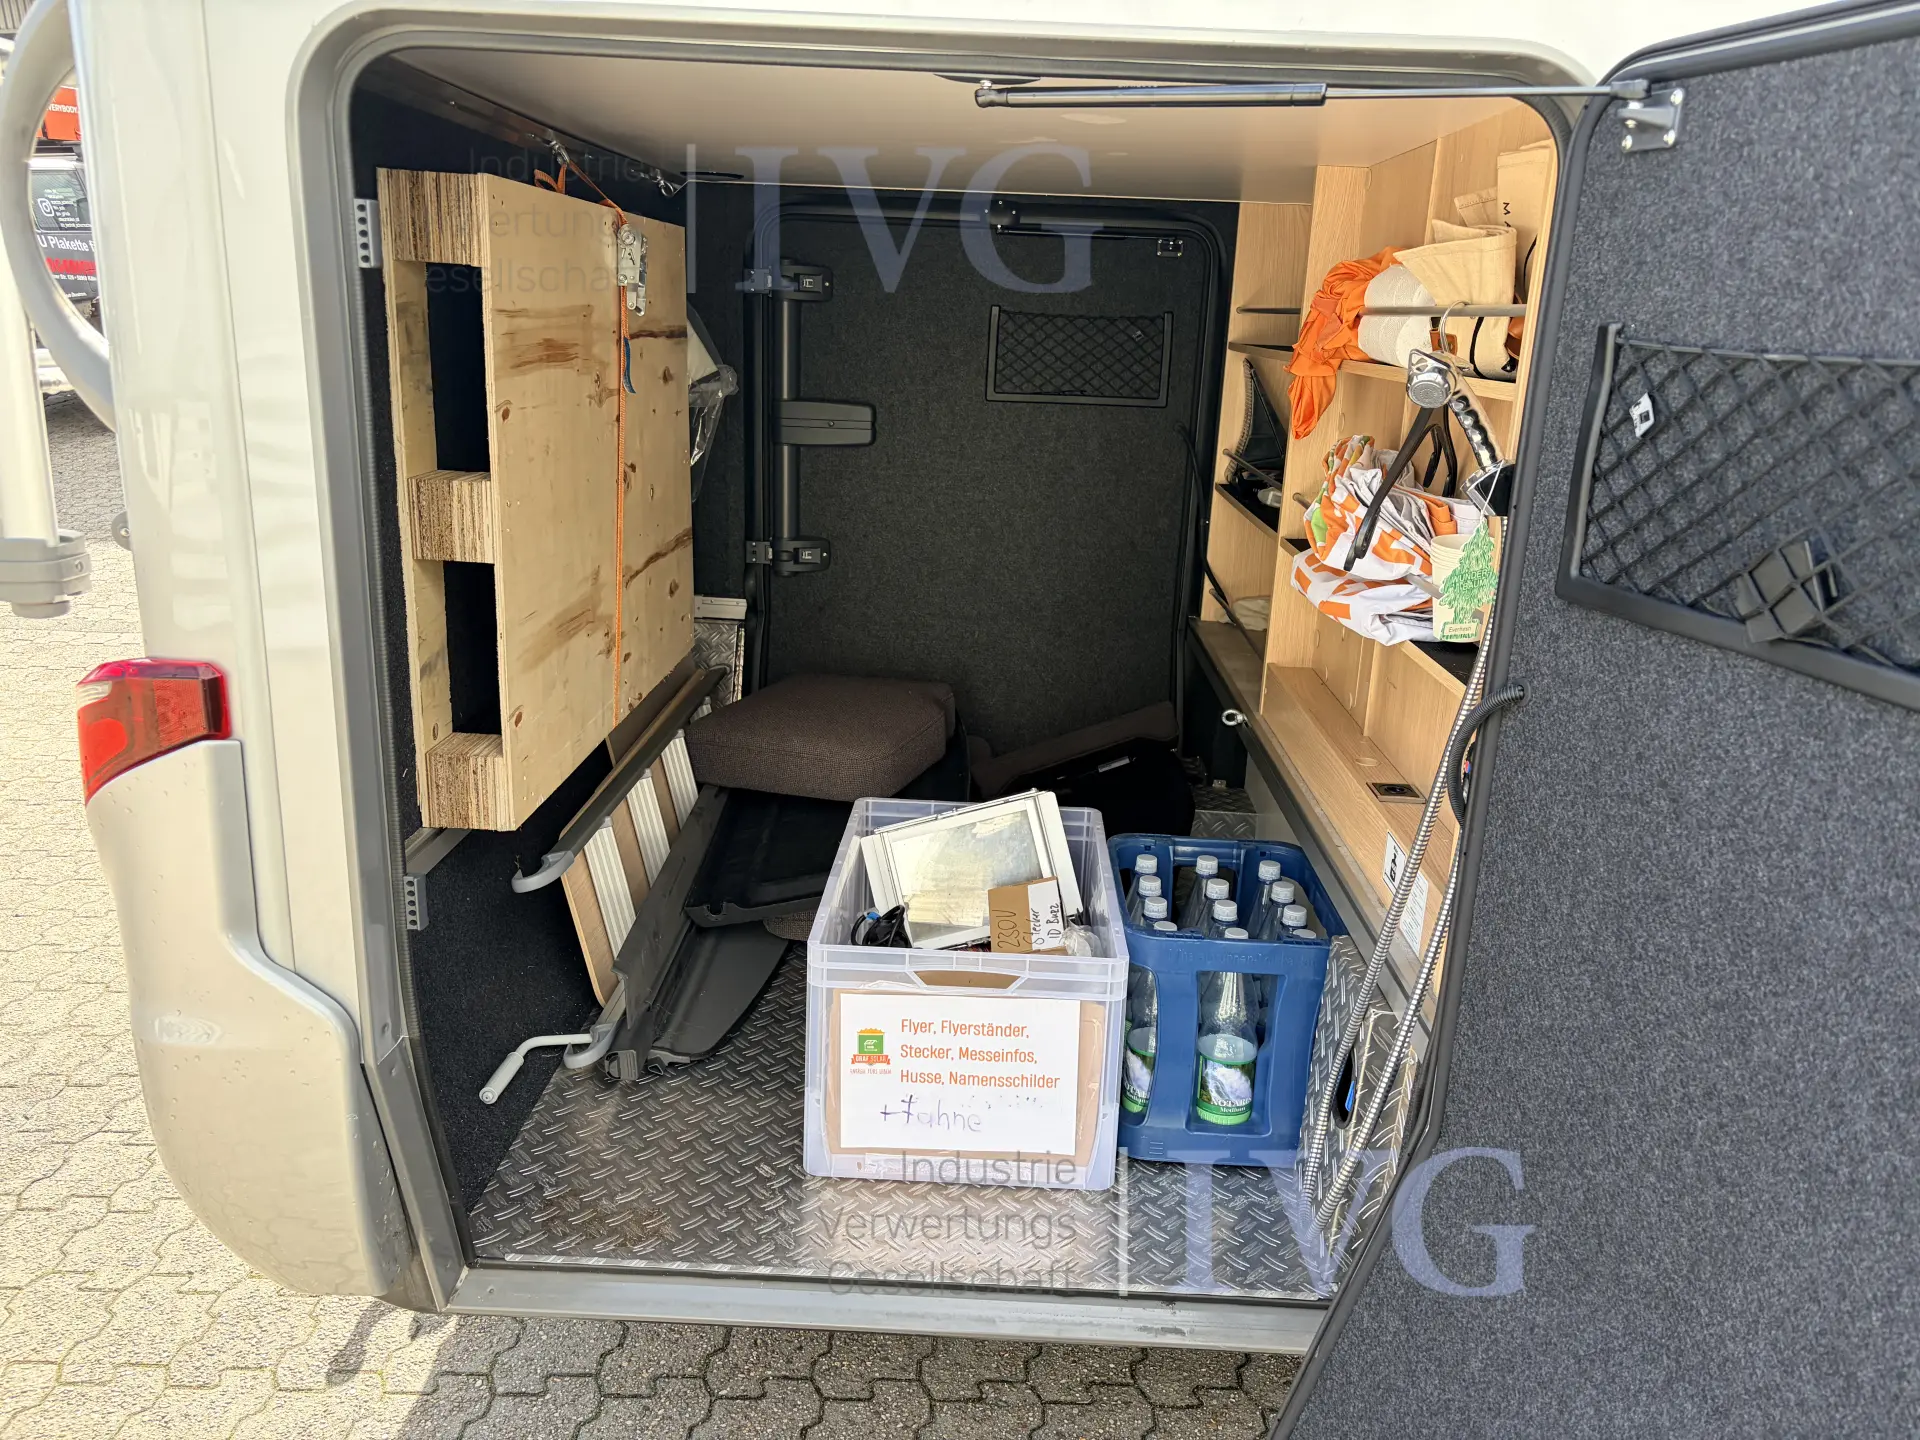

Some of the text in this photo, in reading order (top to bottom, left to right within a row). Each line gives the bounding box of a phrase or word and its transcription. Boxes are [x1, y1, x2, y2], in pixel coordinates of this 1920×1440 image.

[47, 235, 90, 252] Plakette
[1022, 907, 1045, 945] Stecker
[901, 1018, 1030, 1039] Flyer, Flyerständer,
[900, 1044, 1038, 1064] Stecker, Messeinfos,
[900, 1069, 945, 1086] Husse,
[949, 1071, 1061, 1089] Namensschilder
